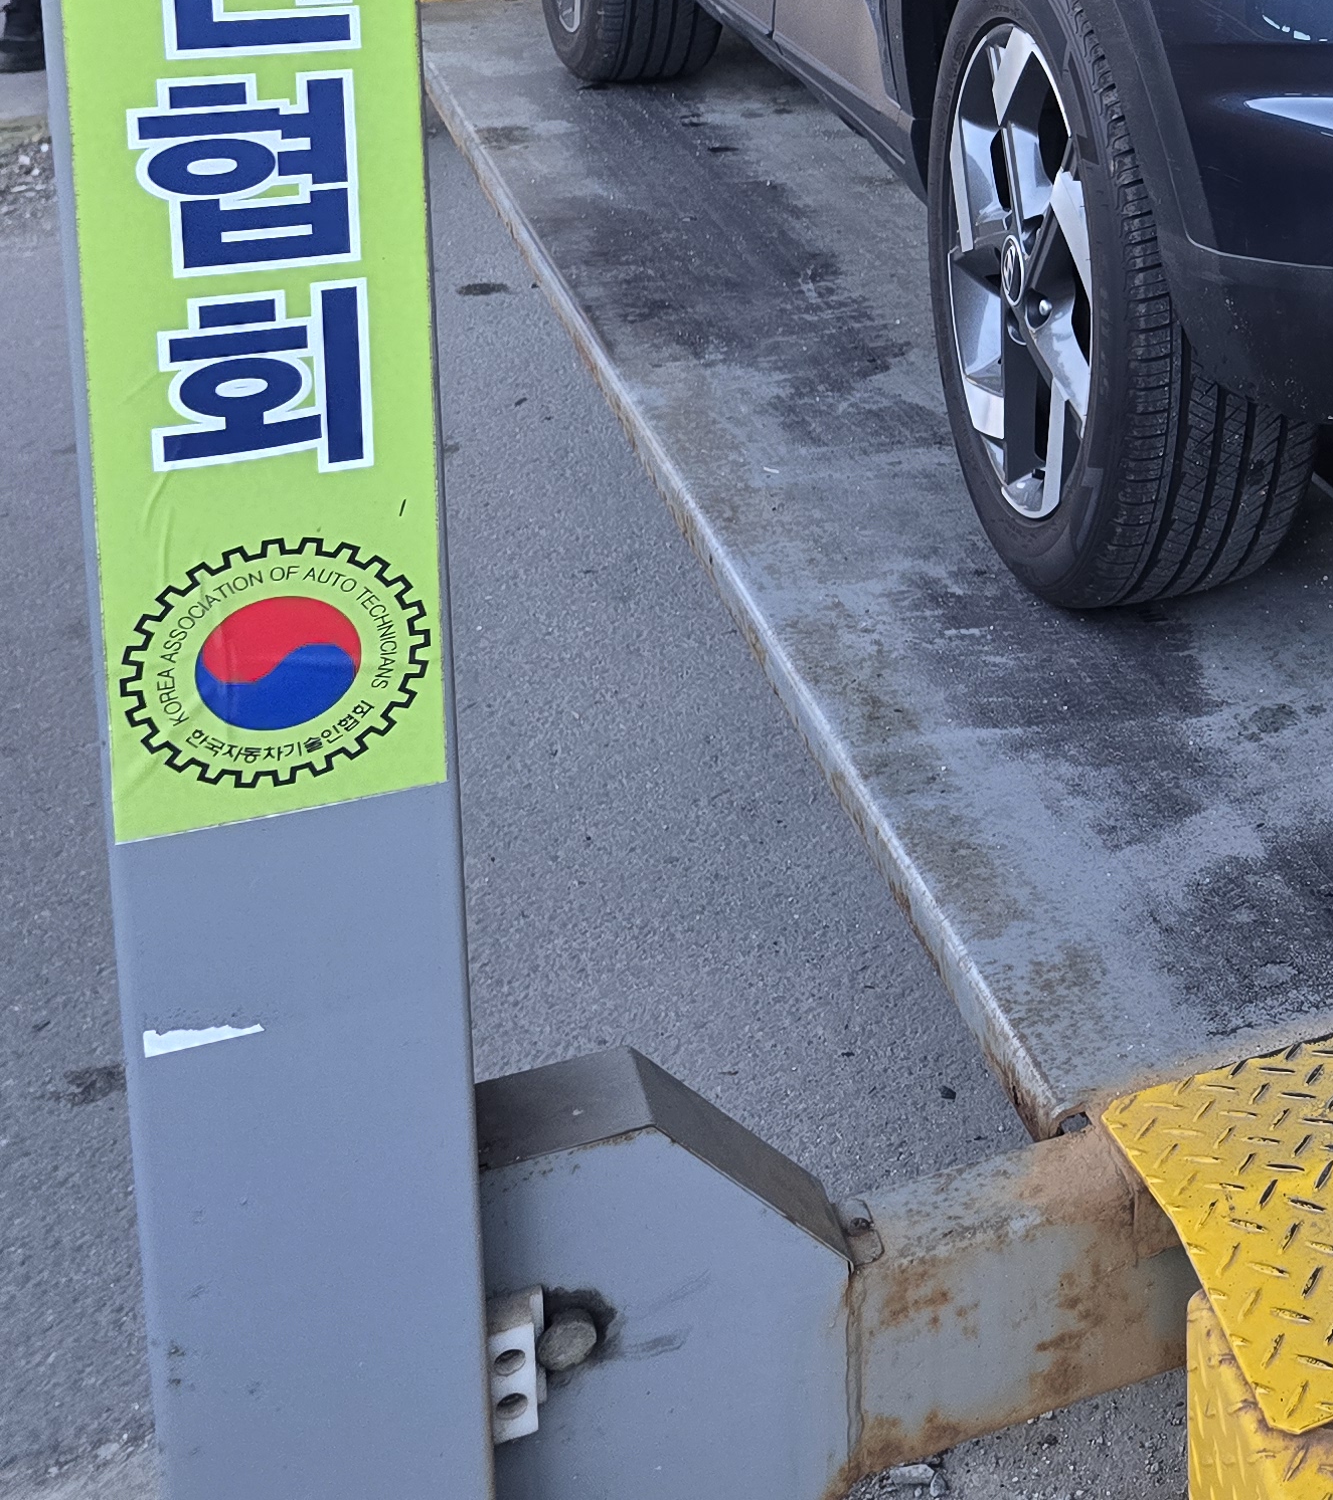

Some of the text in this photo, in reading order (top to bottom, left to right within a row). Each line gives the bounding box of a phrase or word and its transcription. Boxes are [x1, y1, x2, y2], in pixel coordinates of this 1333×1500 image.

[156, 565, 398, 727] KOREA ASSOCIATION OF AUTO TECHNICIANS
[185, 699, 375, 764] 한국자동차기술인협회
